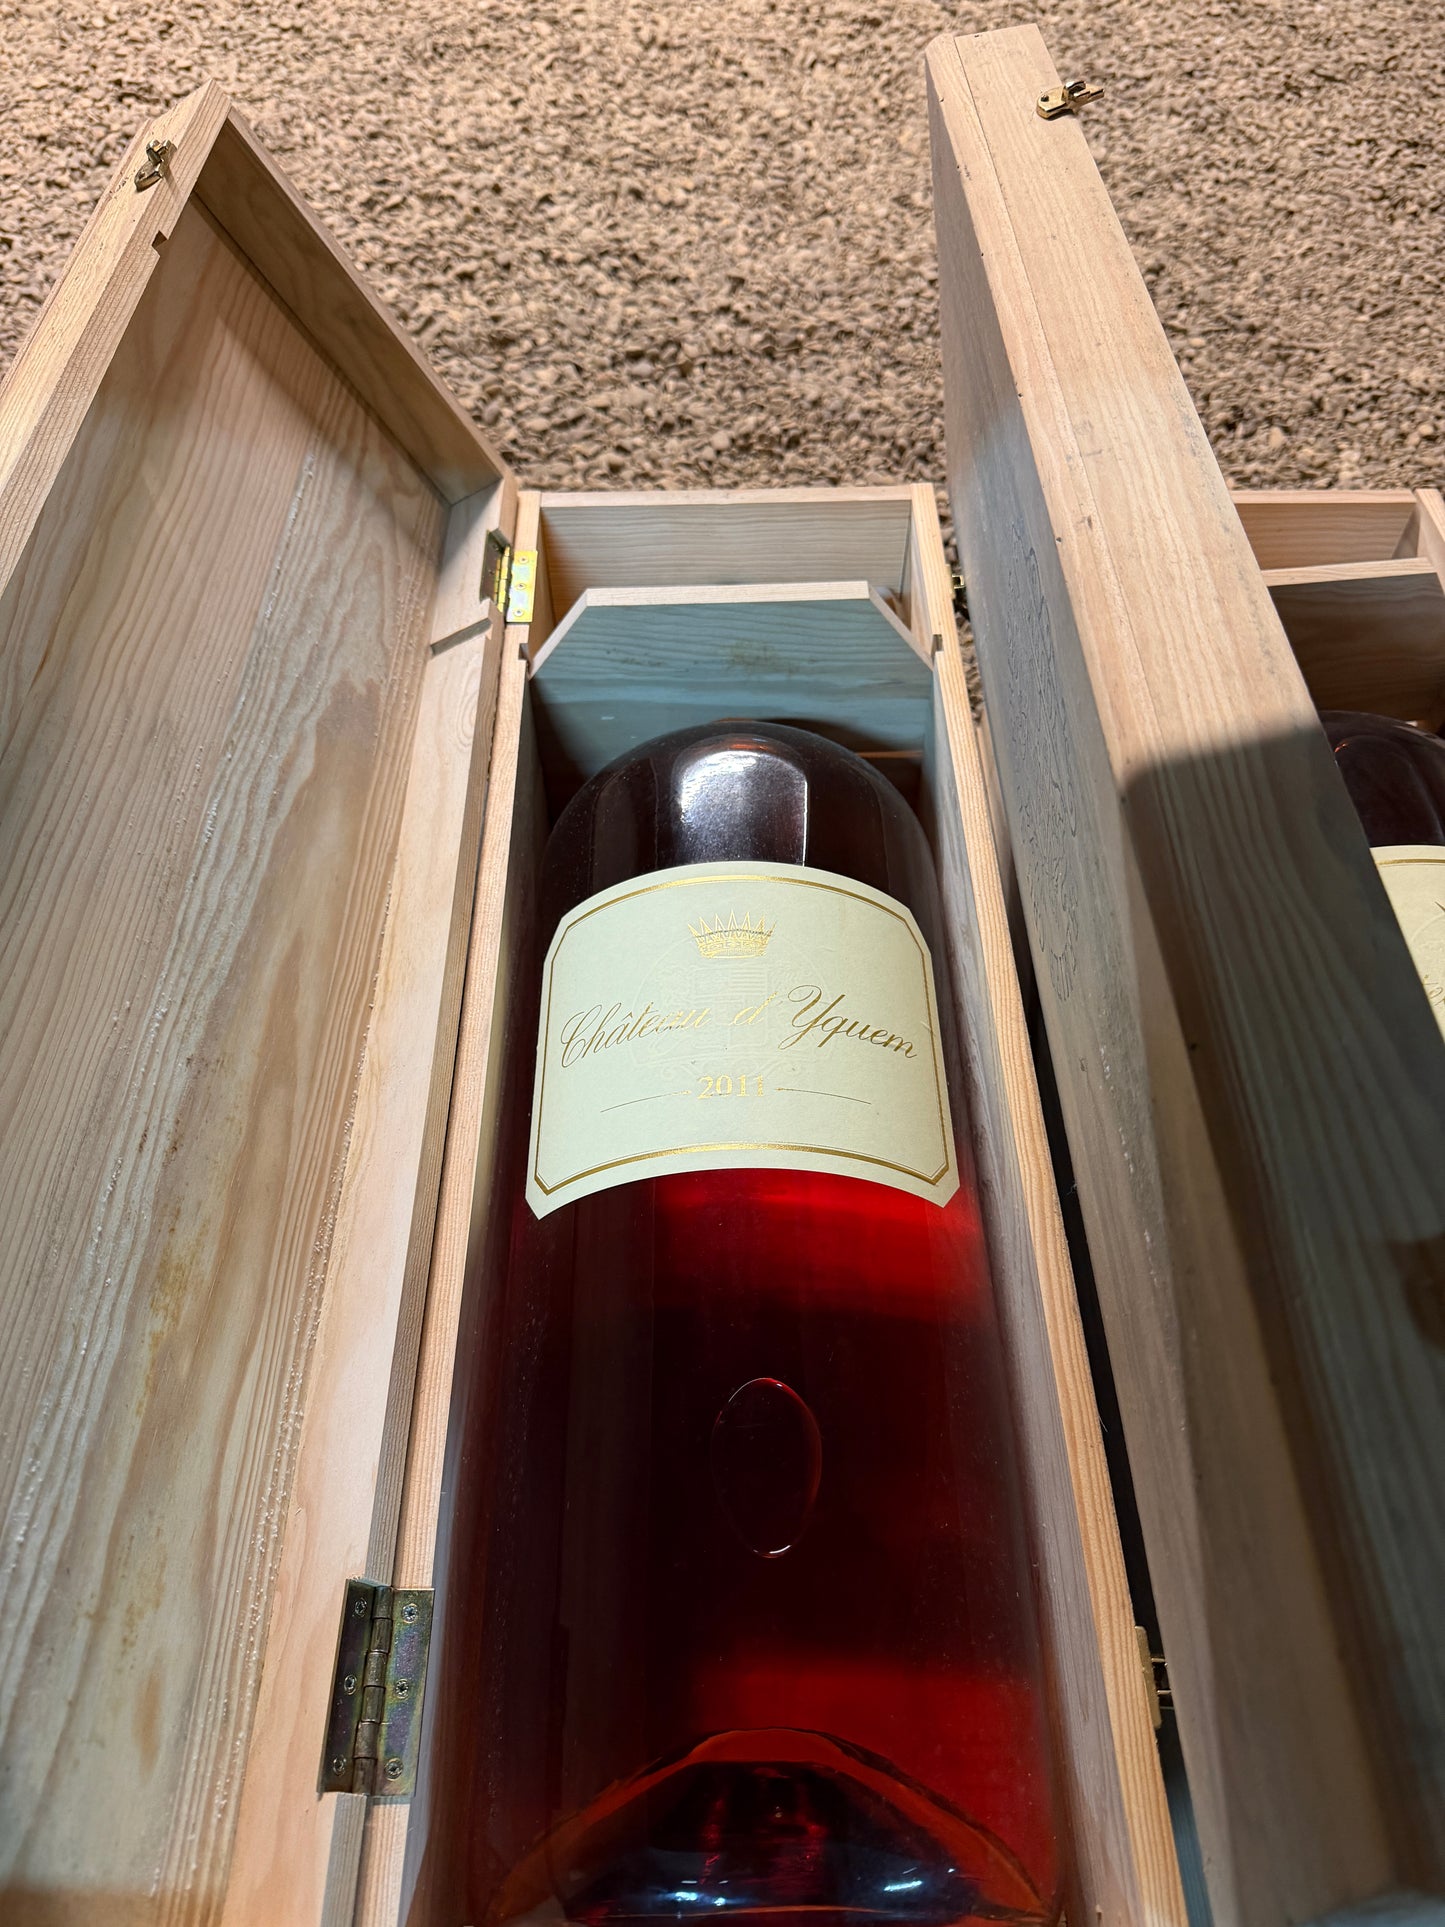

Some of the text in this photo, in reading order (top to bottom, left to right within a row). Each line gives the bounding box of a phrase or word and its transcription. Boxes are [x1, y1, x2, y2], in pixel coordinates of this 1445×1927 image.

[561, 1002, 711, 1068] Château
[778, 984, 917, 1058] Yquem
[697, 1074, 764, 1100] 2011
